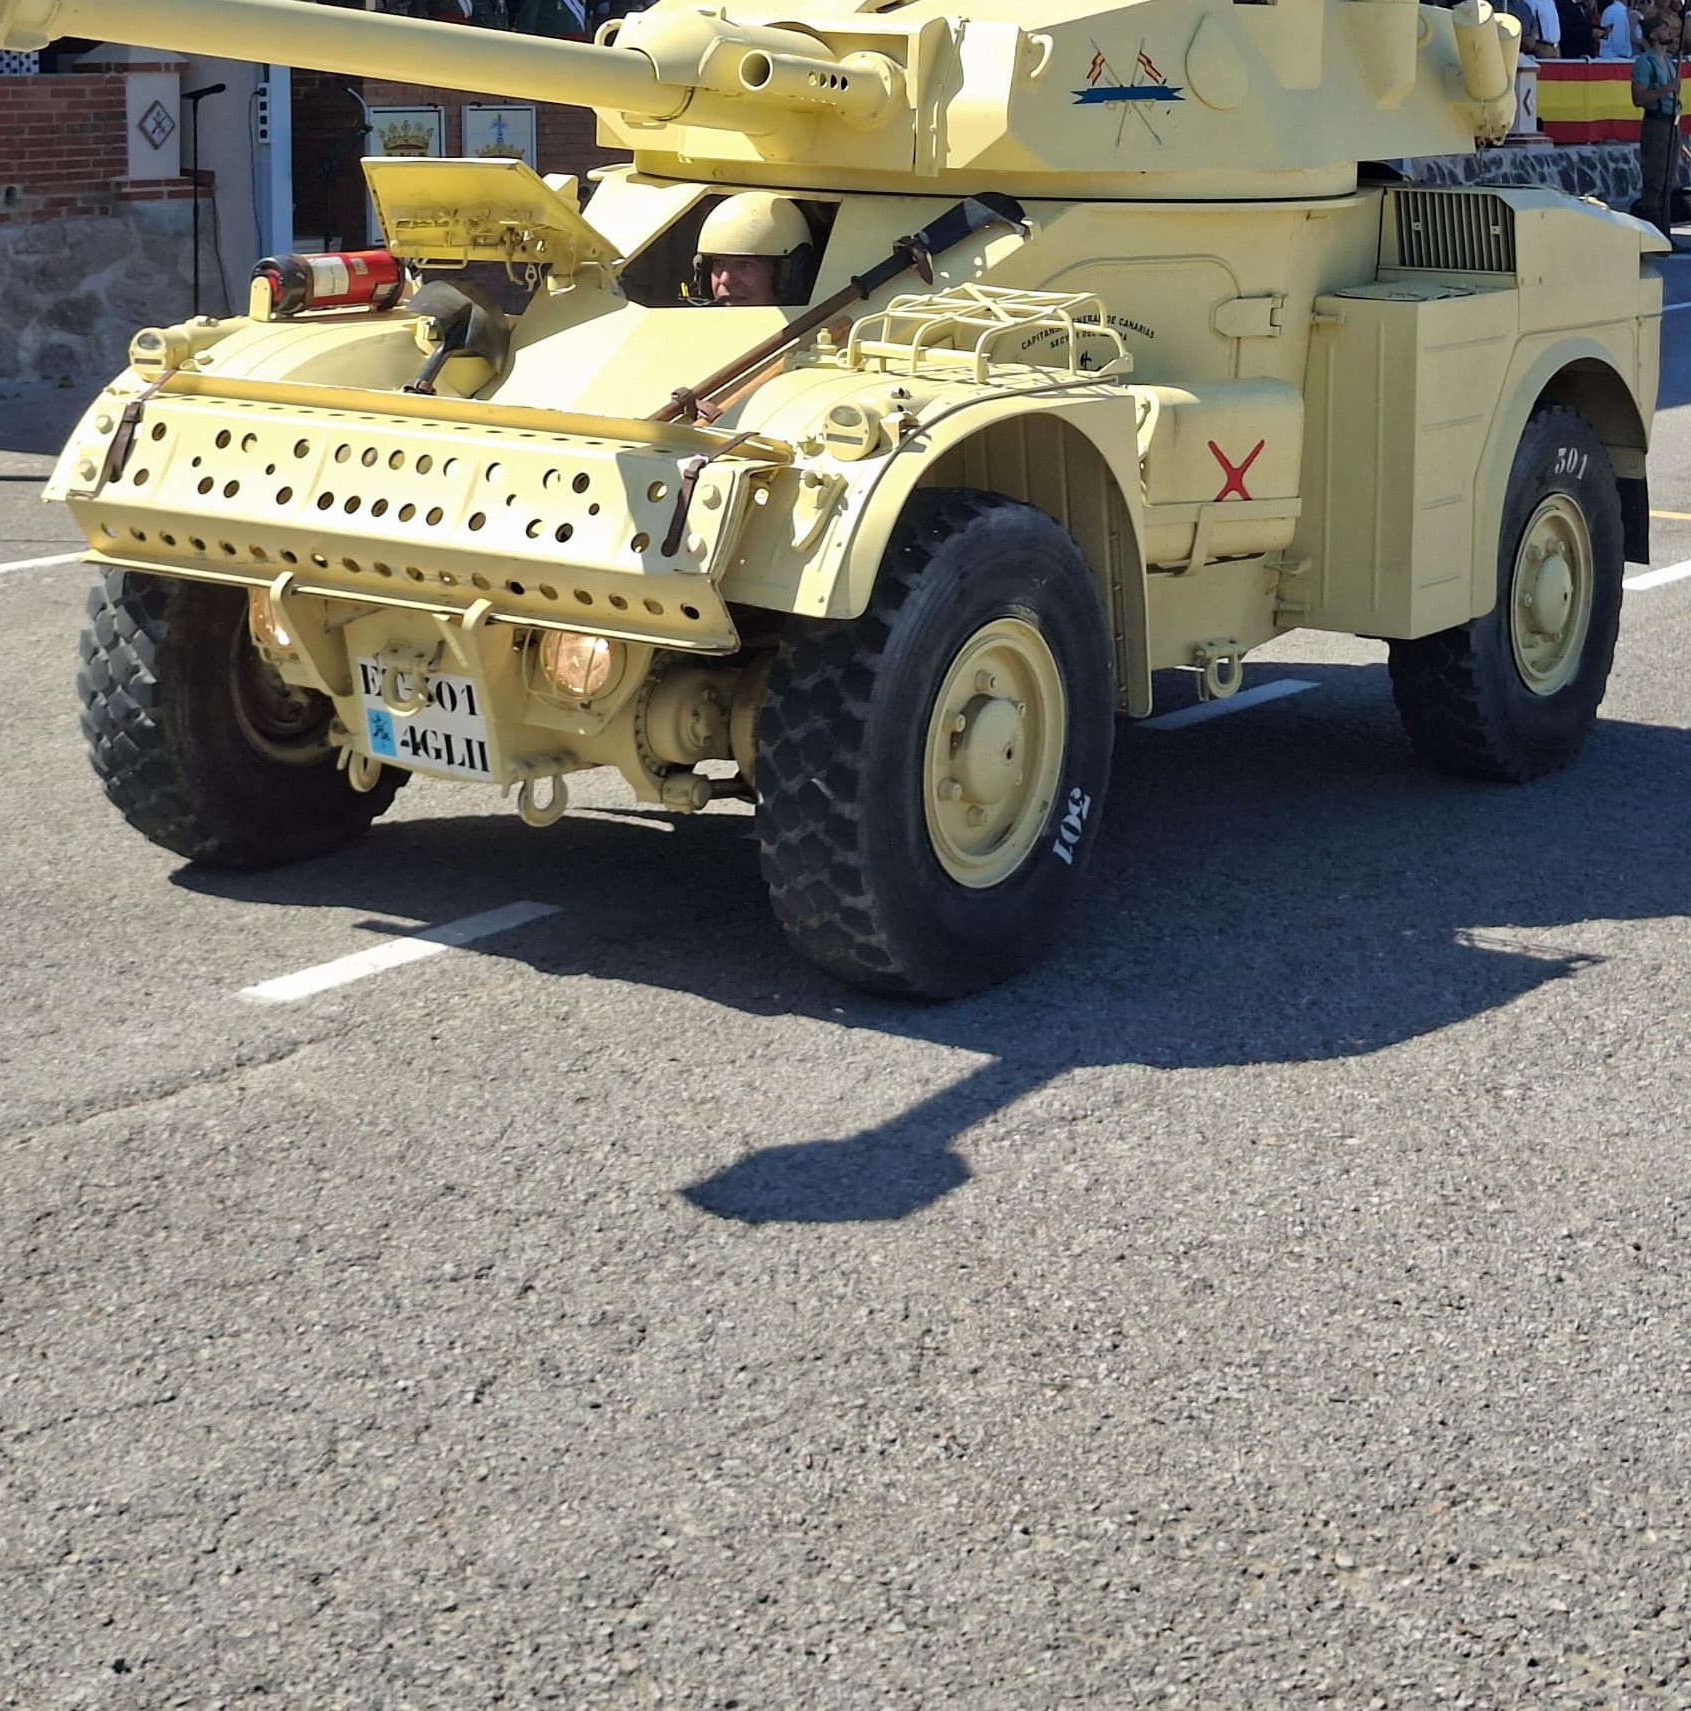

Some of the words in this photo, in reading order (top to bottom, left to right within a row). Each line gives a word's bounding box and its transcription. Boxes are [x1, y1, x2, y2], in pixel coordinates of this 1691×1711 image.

[1021, 328, 1063, 350] CAPITAN
[1119, 317, 1155, 339] CANARIAS
[1050, 331, 1080, 349] SECT
